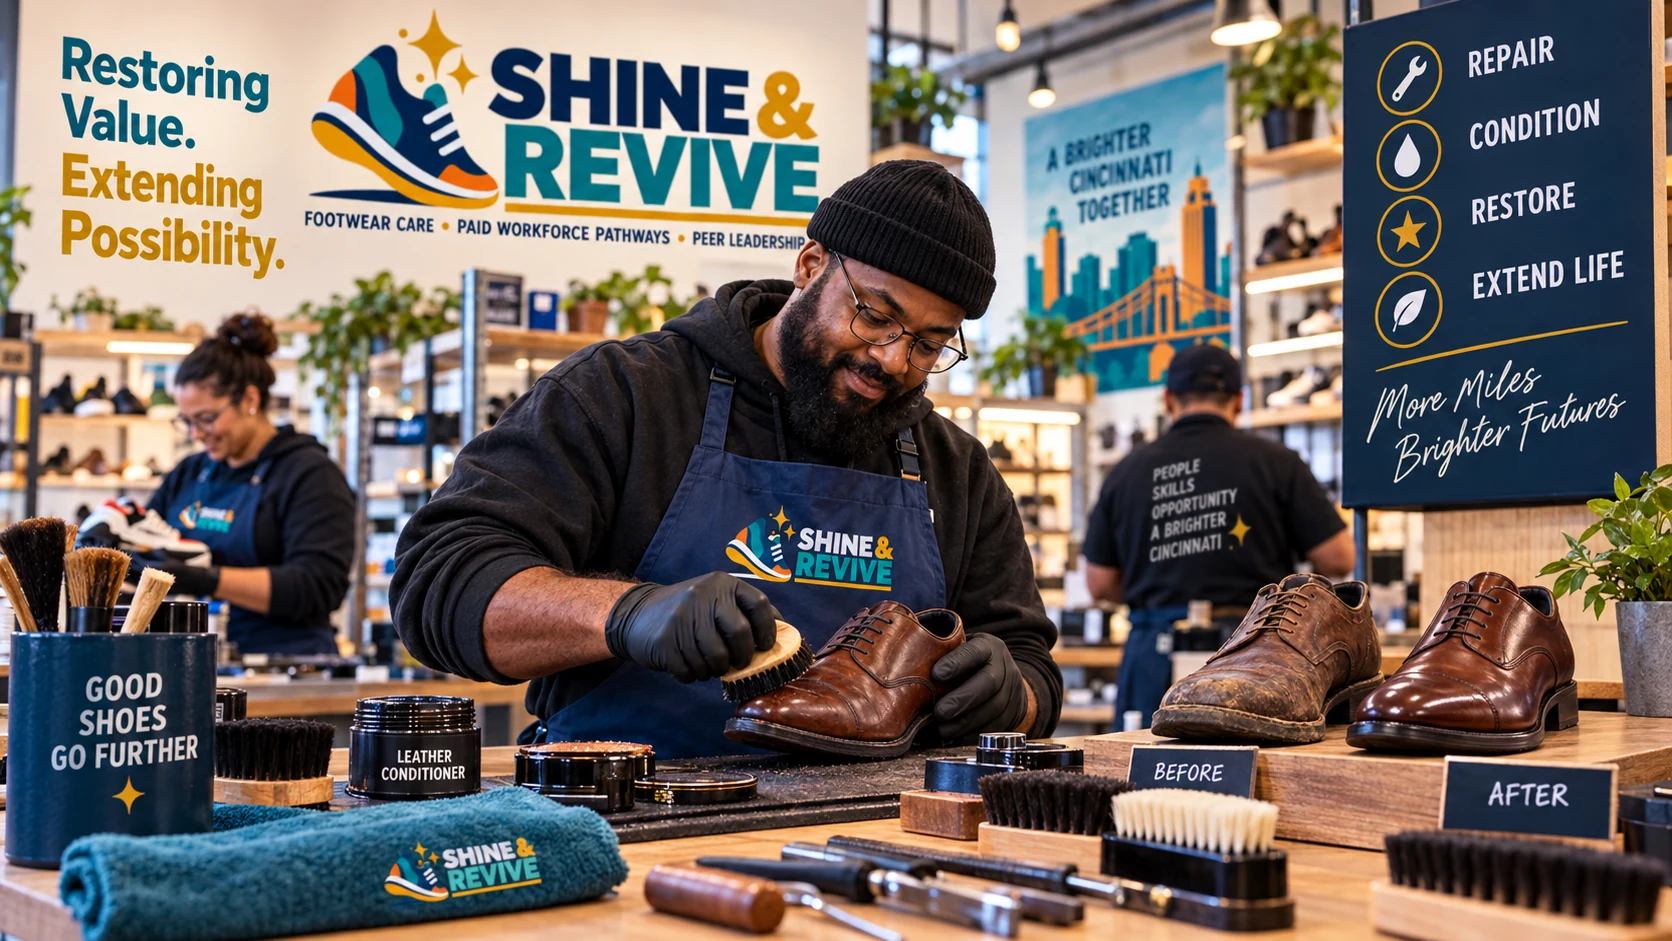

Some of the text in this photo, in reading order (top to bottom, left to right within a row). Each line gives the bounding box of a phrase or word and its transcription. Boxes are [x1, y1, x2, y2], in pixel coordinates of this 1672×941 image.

[62, 36, 269, 113] Restoring
[1468, 35, 1555, 78] REPAIR
[488, 47, 818, 140] SHINE &
[61, 93, 196, 149] Value.
[1469, 98, 1600, 150] CONDITION
[1046, 121, 1151, 172] A BRIGHTER
[62, 152, 263, 220] Extending
[505, 123, 819, 213] REVIVE
[1069, 148, 1172, 195] CINCINNATI
[1077, 182, 1170, 224] TOGETHER
[1471, 181, 1576, 225] RESTORE
[61, 209, 285, 280] Possibility.
[305, 211, 806, 250] FOOTWEAR CARE PAID WORKFORCE PATHWAYS PEER LEADERSHIP
[1473, 250, 1624, 299] EXTEND LIFE
[1366, 360, 1542, 443] More Miles
[1393, 393, 1627, 483] Brighter Futures
[1152, 458, 1201, 482] PEOPLE
[1151, 487, 1238, 520] OPPORTUNITY
[1152, 478, 1195, 501] SKILLS
[797, 527, 894, 560] SHINE &
[1150, 511, 1226, 541] A BRIGHTER
[1149, 533, 1222, 562] CINCINNATI
[795, 551, 893, 585] REVIVE
[85, 672, 163, 702] GOOD
[78, 704, 167, 736] SHOES
[51, 734, 199, 771] GO FURTHER
[397, 749, 452, 763] LEATHER
[381, 766, 466, 781] CONDITIONER
[1153, 762, 1224, 782] BEFORE
[1488, 781, 1569, 807] AFTER
[442, 837, 536, 869] SHINE &
[447, 856, 540, 892] REVIVE
